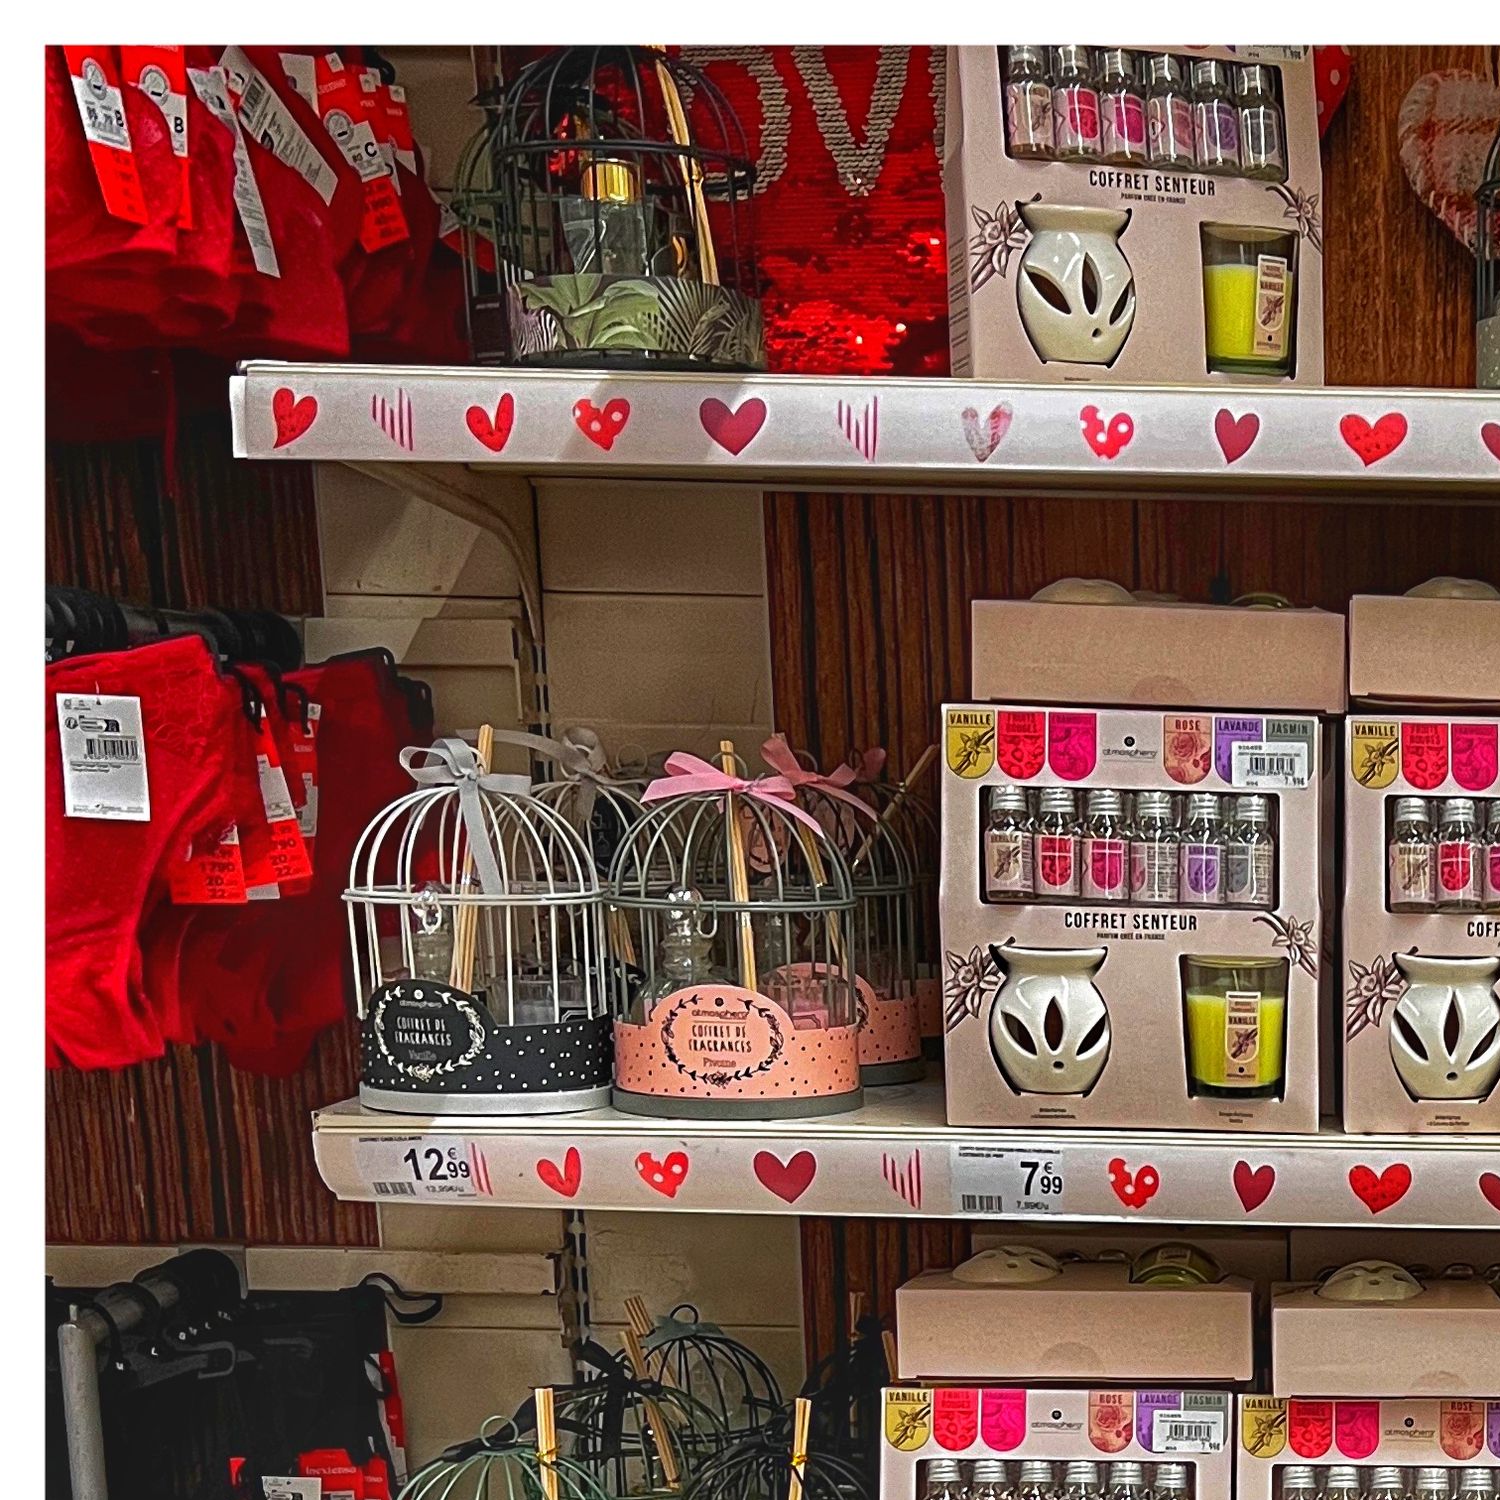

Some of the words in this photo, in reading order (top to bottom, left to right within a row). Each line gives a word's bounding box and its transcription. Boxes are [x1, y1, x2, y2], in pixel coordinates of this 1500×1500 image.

[1089, 170, 1149, 190] COFFRET
[1155, 172, 1215, 196] SENTEUR
[950, 713, 991, 725] VANILLE
[1175, 719, 1200, 731] ROSE
[1218, 720, 1260, 732] LAVANDE
[1271, 723, 1308, 735] JASMIN
[1355, 725, 1396, 737] VANILLE
[1065, 912, 1126, 929] COFFRET
[1133, 914, 1197, 930] SENTEUR
[396, 1016, 431, 1030] COFFRET
[434, 1018, 446, 1031] DE
[692, 1024, 731, 1038] COFFRET
[735, 1025, 746, 1038] DE
[394, 1031, 452, 1046] FRAGRANCES
[688, 1039, 752, 1053] FRAGRANCES
[888, 1391, 928, 1402] VANILLE
[1099, 1393, 1124, 1405] ROSE
[1188, 1395, 1223, 1405] JASMIN
[1244, 1399, 1285, 1410] VANILLE
[1450, 1402, 1473, 1412] ROSE
